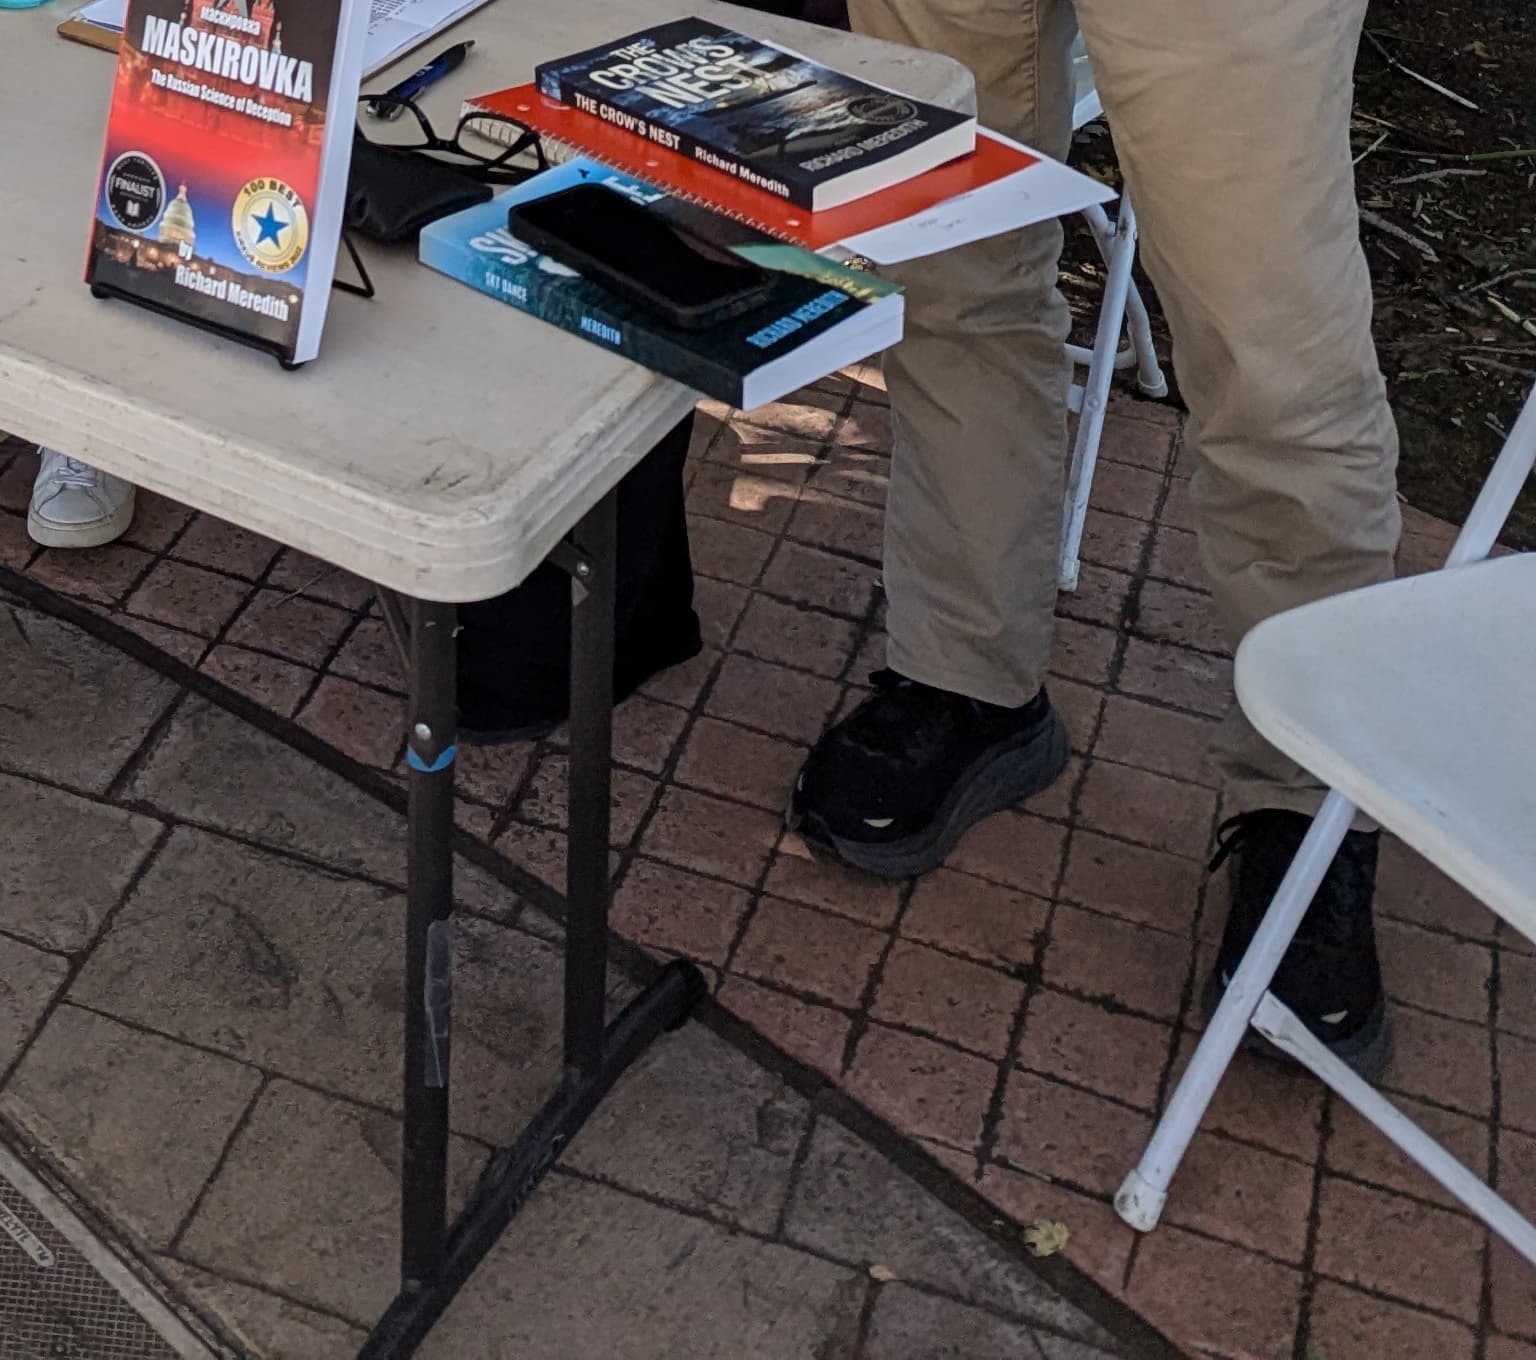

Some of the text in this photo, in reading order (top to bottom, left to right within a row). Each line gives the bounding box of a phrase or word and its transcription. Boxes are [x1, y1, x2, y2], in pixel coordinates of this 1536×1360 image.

[141, 14, 313, 103] MASKIROVKA
[610, 40, 657, 60] THE
[151, 68, 293, 127] The Russian Science of Deception
[636, 54, 766, 109] NEST
[574, 92, 791, 199] THE CROW'S NEST Richard Meredith
[799, 118, 929, 172] RICHARD MEREDITH
[115, 178, 156, 199] FINALIST
[244, 180, 302, 208] 100 BEST
[178, 240, 193, 260] by
[175, 265, 289, 322] Richard Meredith
[501, 281, 528, 302] DANCE
[580, 315, 621, 345] MEREDITH
